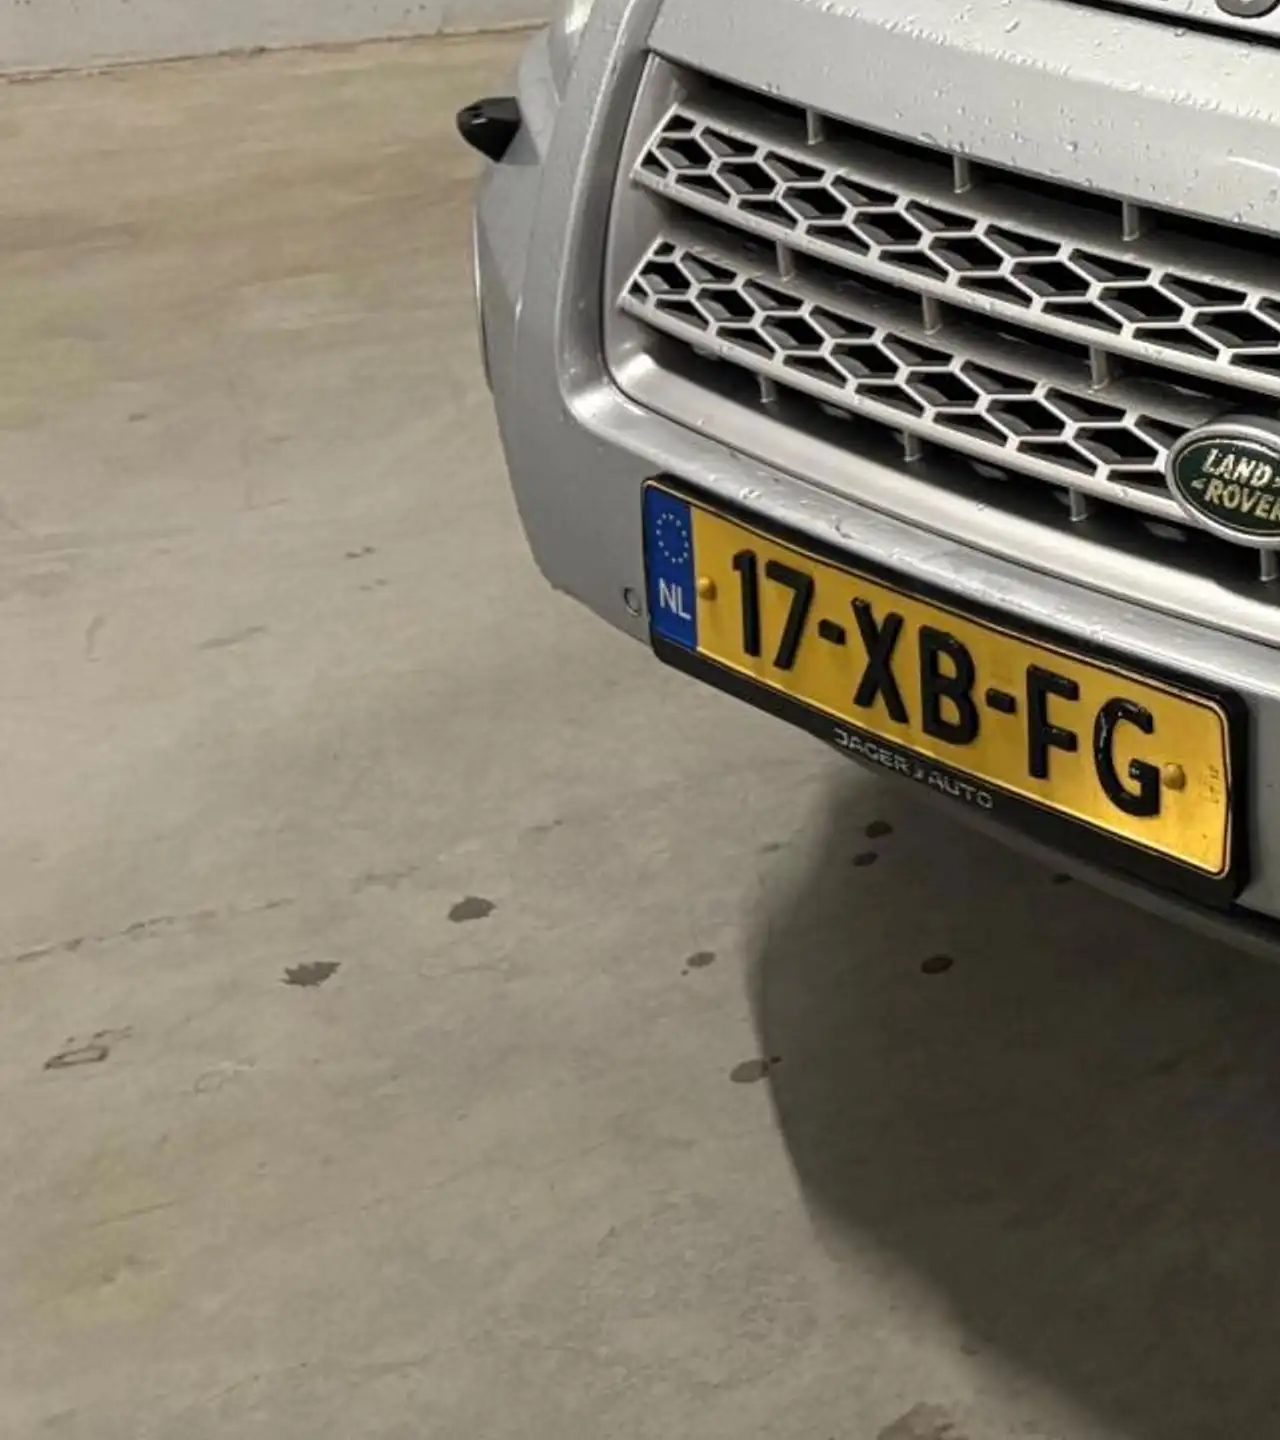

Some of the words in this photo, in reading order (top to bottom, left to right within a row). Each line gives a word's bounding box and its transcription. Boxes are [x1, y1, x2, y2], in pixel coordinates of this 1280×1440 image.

[1202, 447, 1274, 488] LAND
[658, 577, 692, 621] NL
[732, 548, 1162, 817] 17-XB-FG
[927, 770, 994, 809] AUTO
